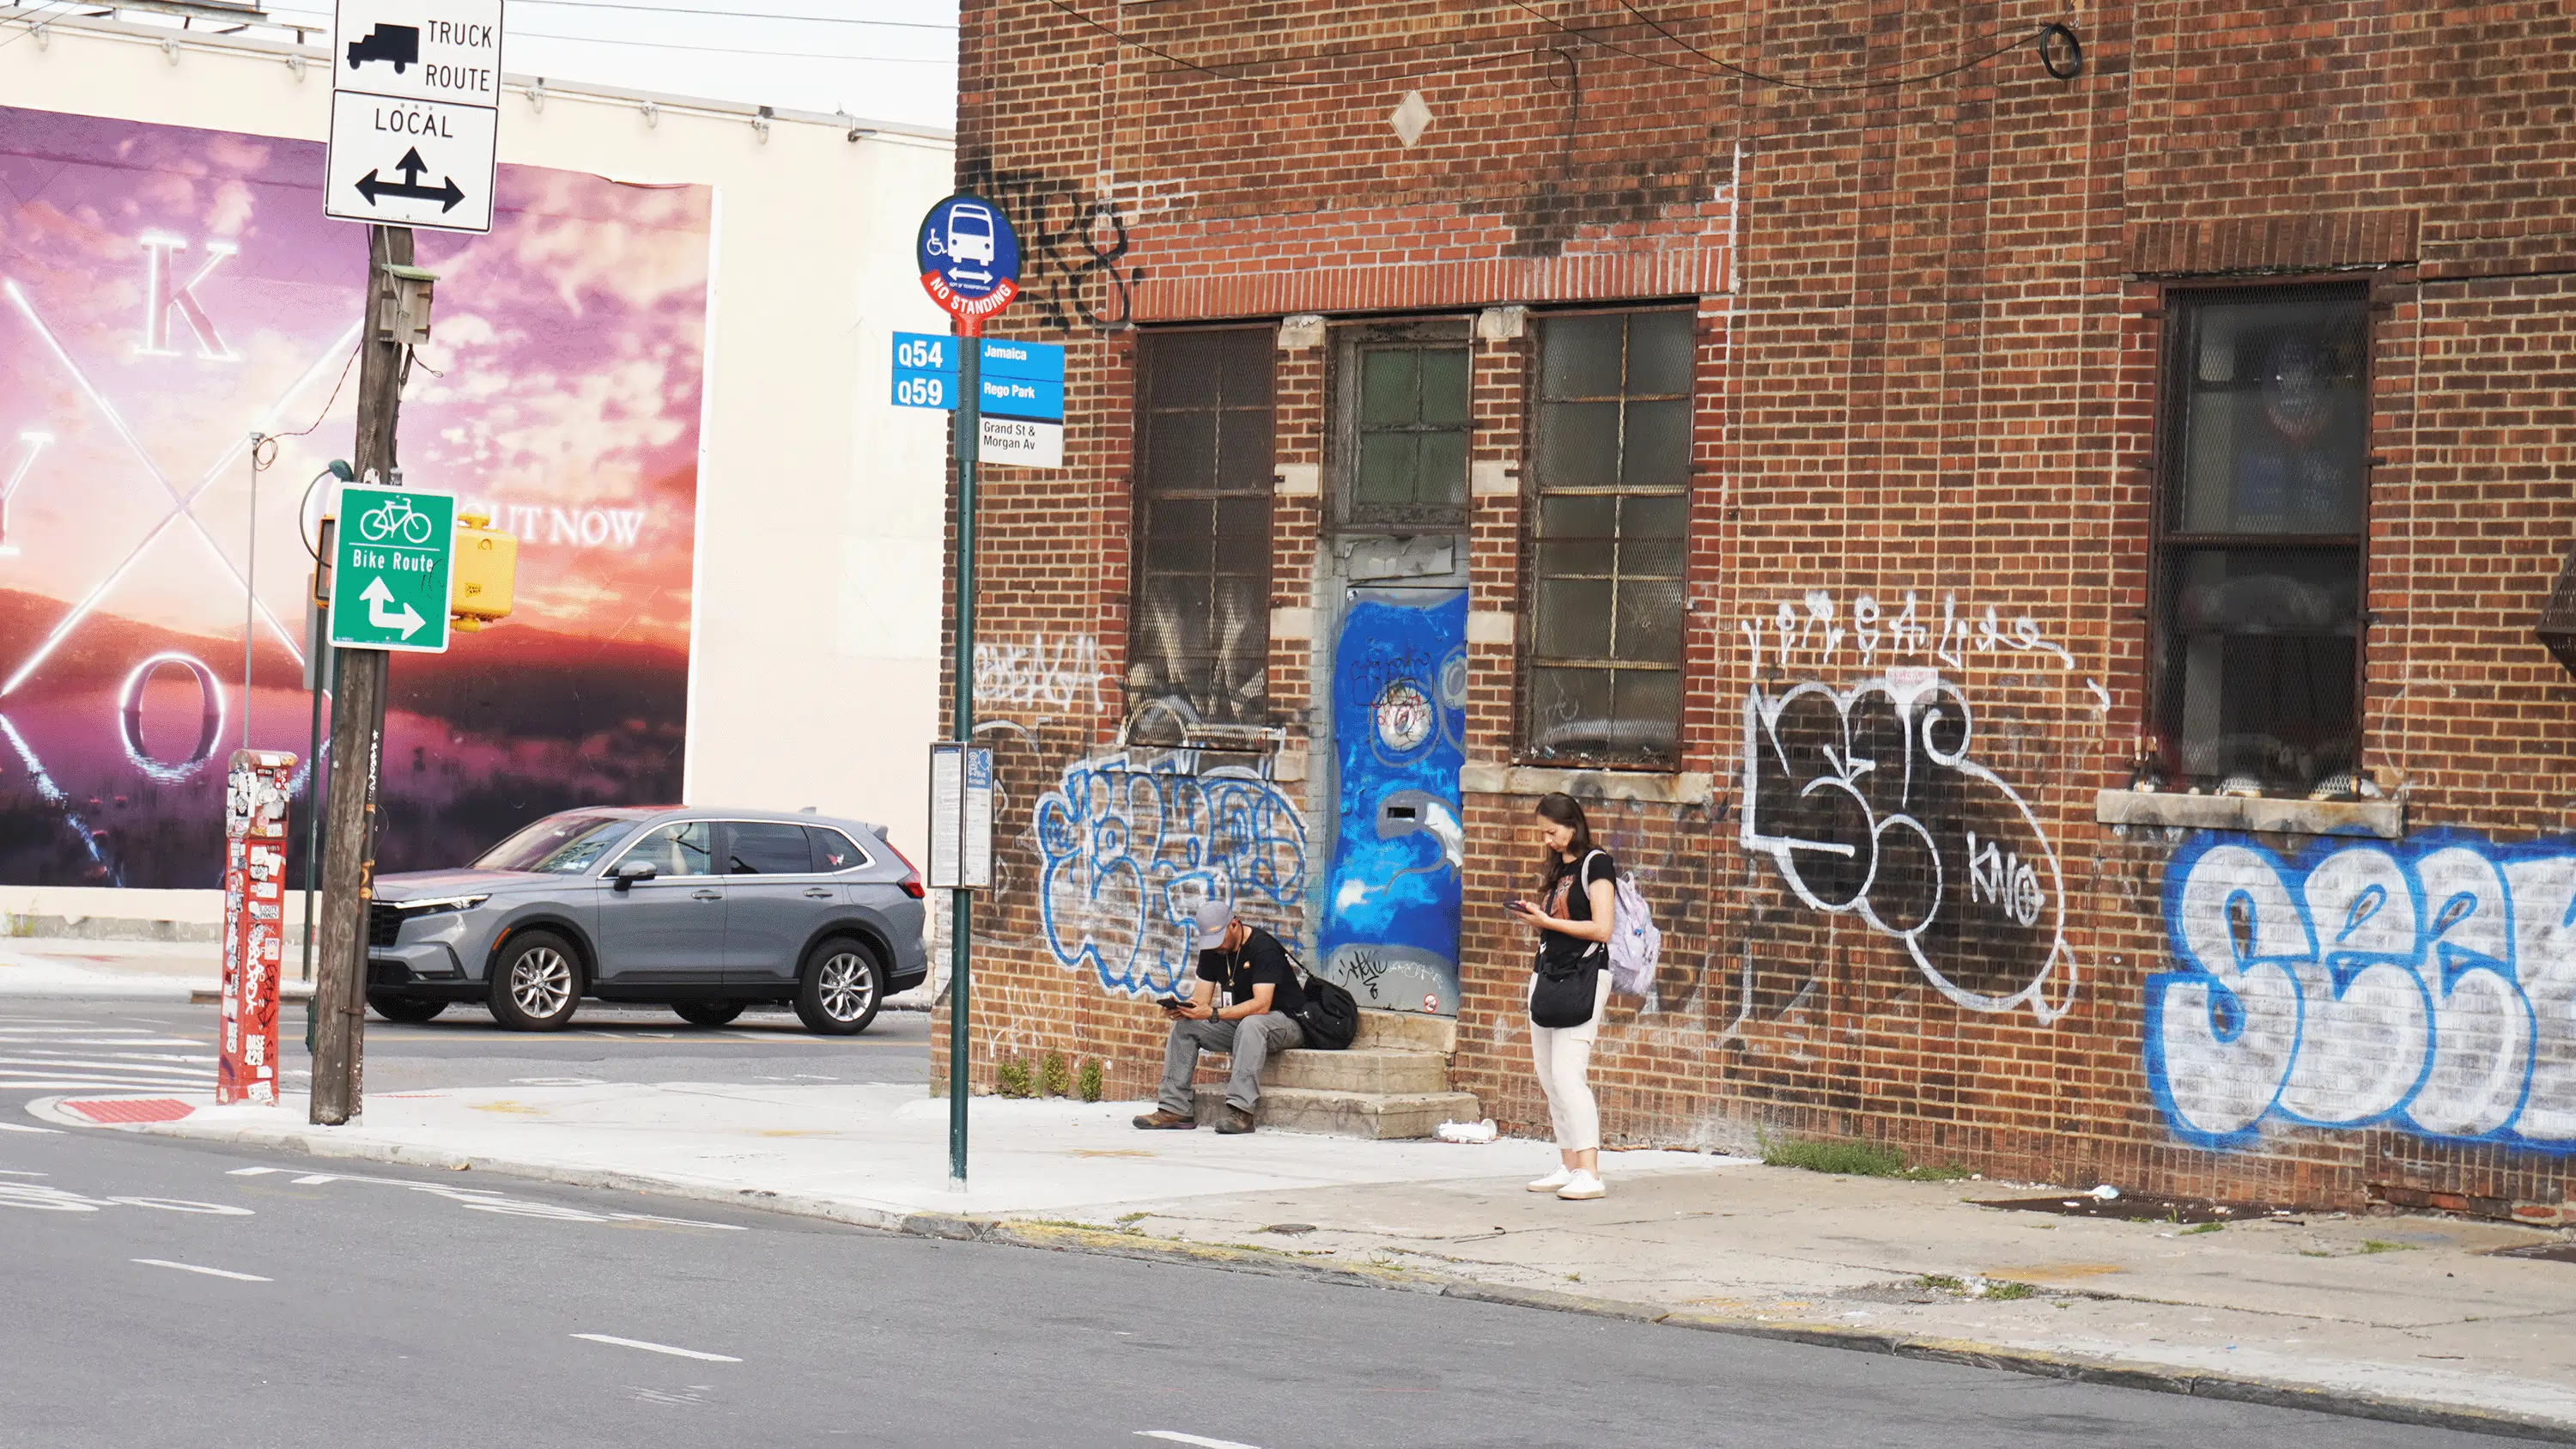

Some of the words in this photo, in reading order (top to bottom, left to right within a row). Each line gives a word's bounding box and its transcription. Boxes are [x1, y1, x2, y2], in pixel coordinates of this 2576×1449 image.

[428, 20, 492, 48] TRUCK
[426, 64, 490, 92] ROUTE
[375, 108, 453, 138] LOCAL
[137, 234, 240, 362] K
[930, 277, 950, 300] NO
[951, 284, 1012, 314] STANDING
[898, 340, 943, 368] Q54
[984, 345, 1027, 361] Jamaica
[897, 378, 943, 405] Q59
[984, 382, 1010, 398] Rego
[1012, 384, 1036, 399] Park
[983, 435, 1020, 450] Morgan
[1024, 439, 1036, 450] Av
[984, 422, 1012, 435] Grand
[1015, 423, 1026, 436] St
[1028, 426, 1036, 436] &
[552, 508, 646, 545] NOW
[353, 549, 386, 569] Bike
[392, 551, 434, 572] Route
